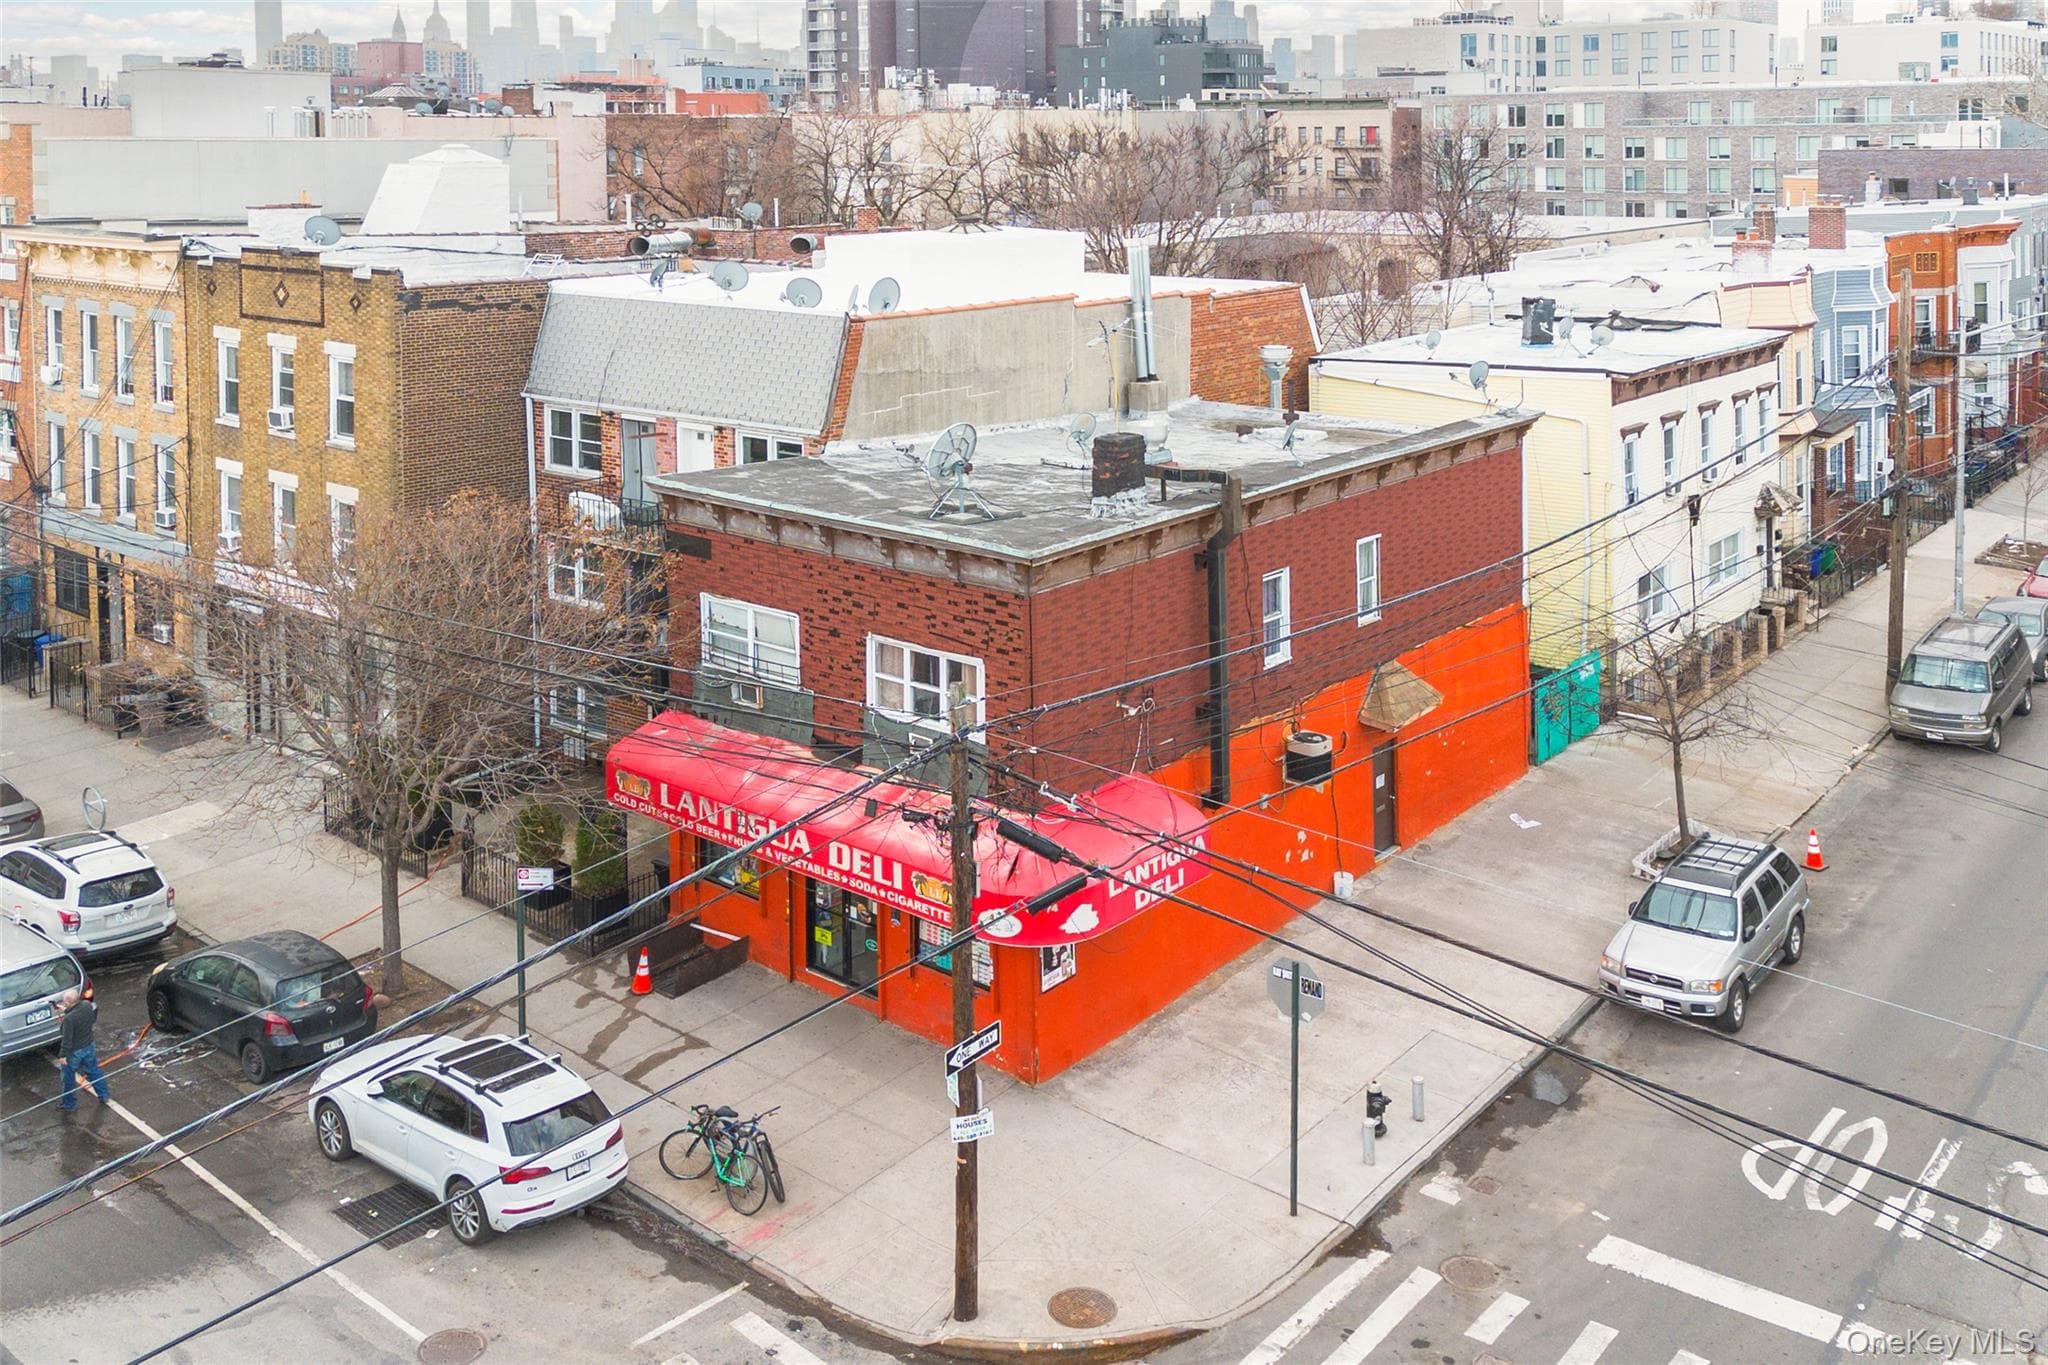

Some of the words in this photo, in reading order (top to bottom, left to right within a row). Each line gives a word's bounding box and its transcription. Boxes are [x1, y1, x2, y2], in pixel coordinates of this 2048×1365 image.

[613, 792, 637, 808] COLD
[638, 802, 663, 818] CUTS
[669, 814, 694, 830] COLD
[696, 822, 721, 839] BEER
[728, 834, 763, 854] FRU
[765, 847, 773, 857] &
[774, 850, 841, 881] VEGETABLES
[849, 877, 878, 896] SODA
[660, 783, 813, 858] LANTIGUA
[829, 841, 902, 890] DELI
[1108, 835, 1206, 898] LANTIGUA
[1135, 868, 1184, 910] DELI
[957, 1046, 970, 1063] ONE
[978, 1031, 994, 1048] WAY
[956, 1118, 988, 1129] HOUSES
